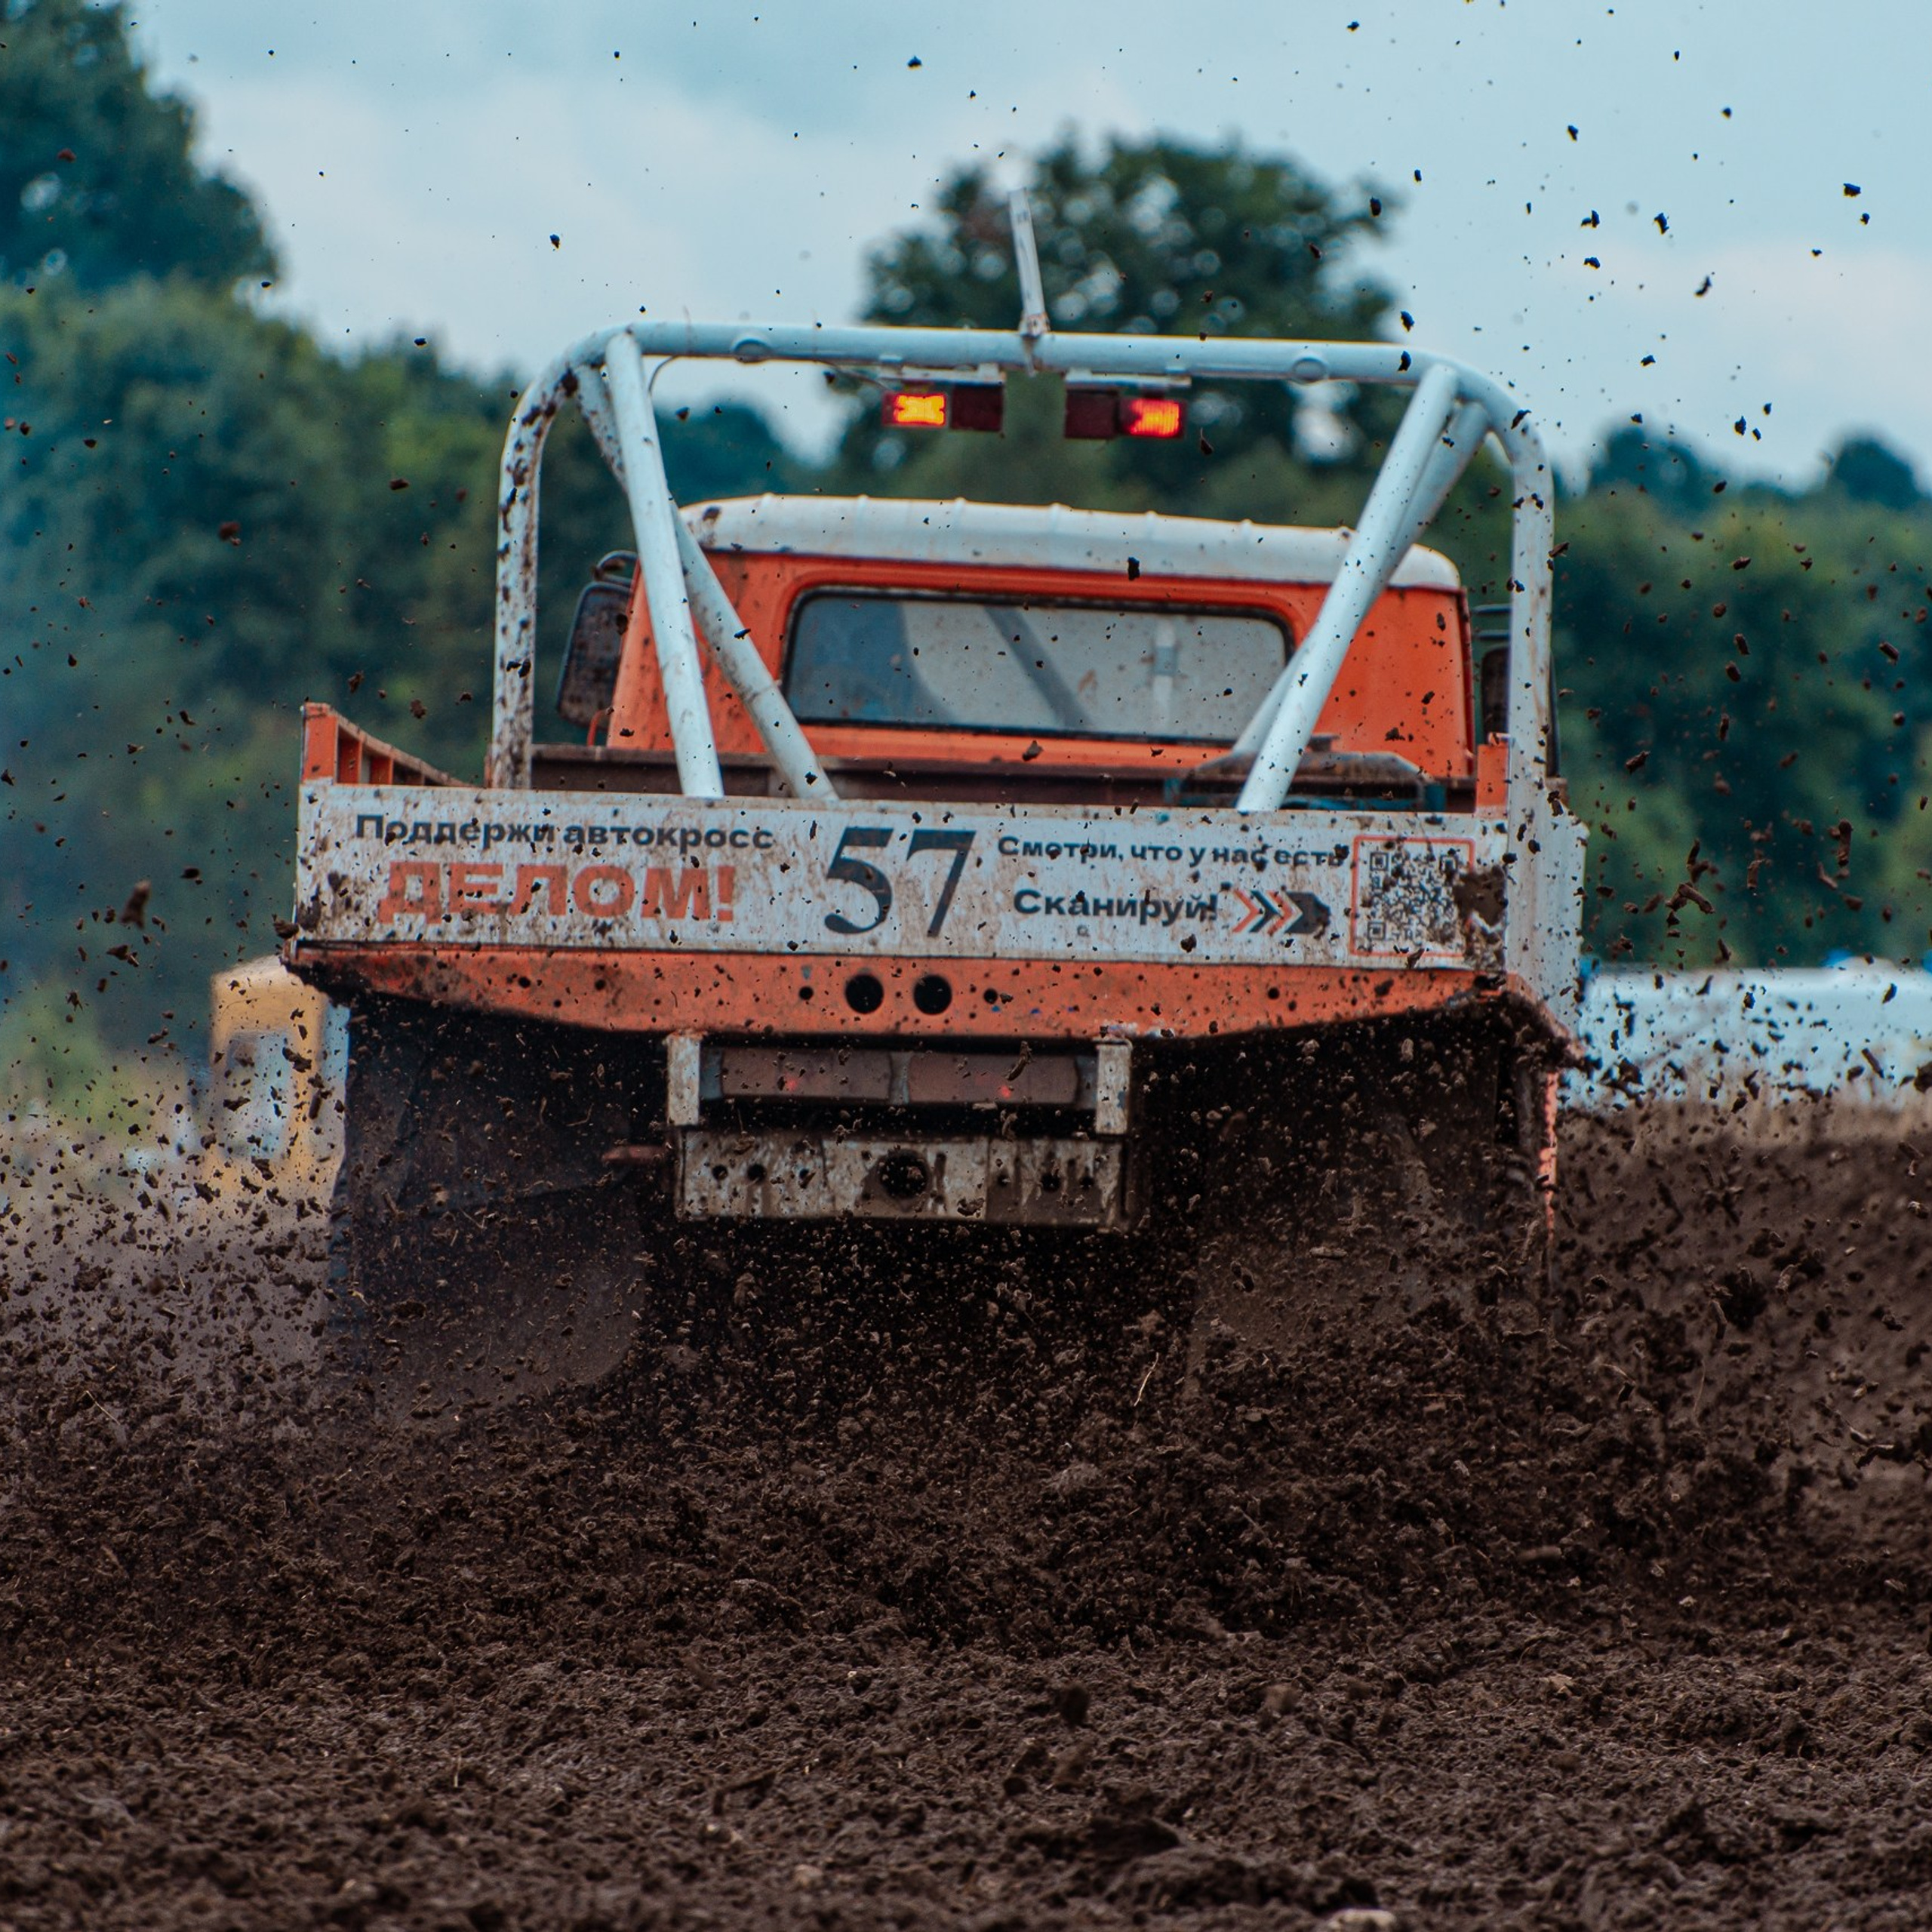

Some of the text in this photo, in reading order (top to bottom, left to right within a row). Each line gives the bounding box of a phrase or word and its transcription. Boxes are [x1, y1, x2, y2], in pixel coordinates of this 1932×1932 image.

[356, 814, 774, 855] Поддержи автокросс
[1131, 844, 1183, 862] что
[1189, 845, 1206, 866] у
[1212, 847, 1266, 867] нас
[377, 860, 735, 924] ДЕЛОМ!
[823, 826, 977, 937] 57
[1013, 889, 1218, 926] Сканируй!
